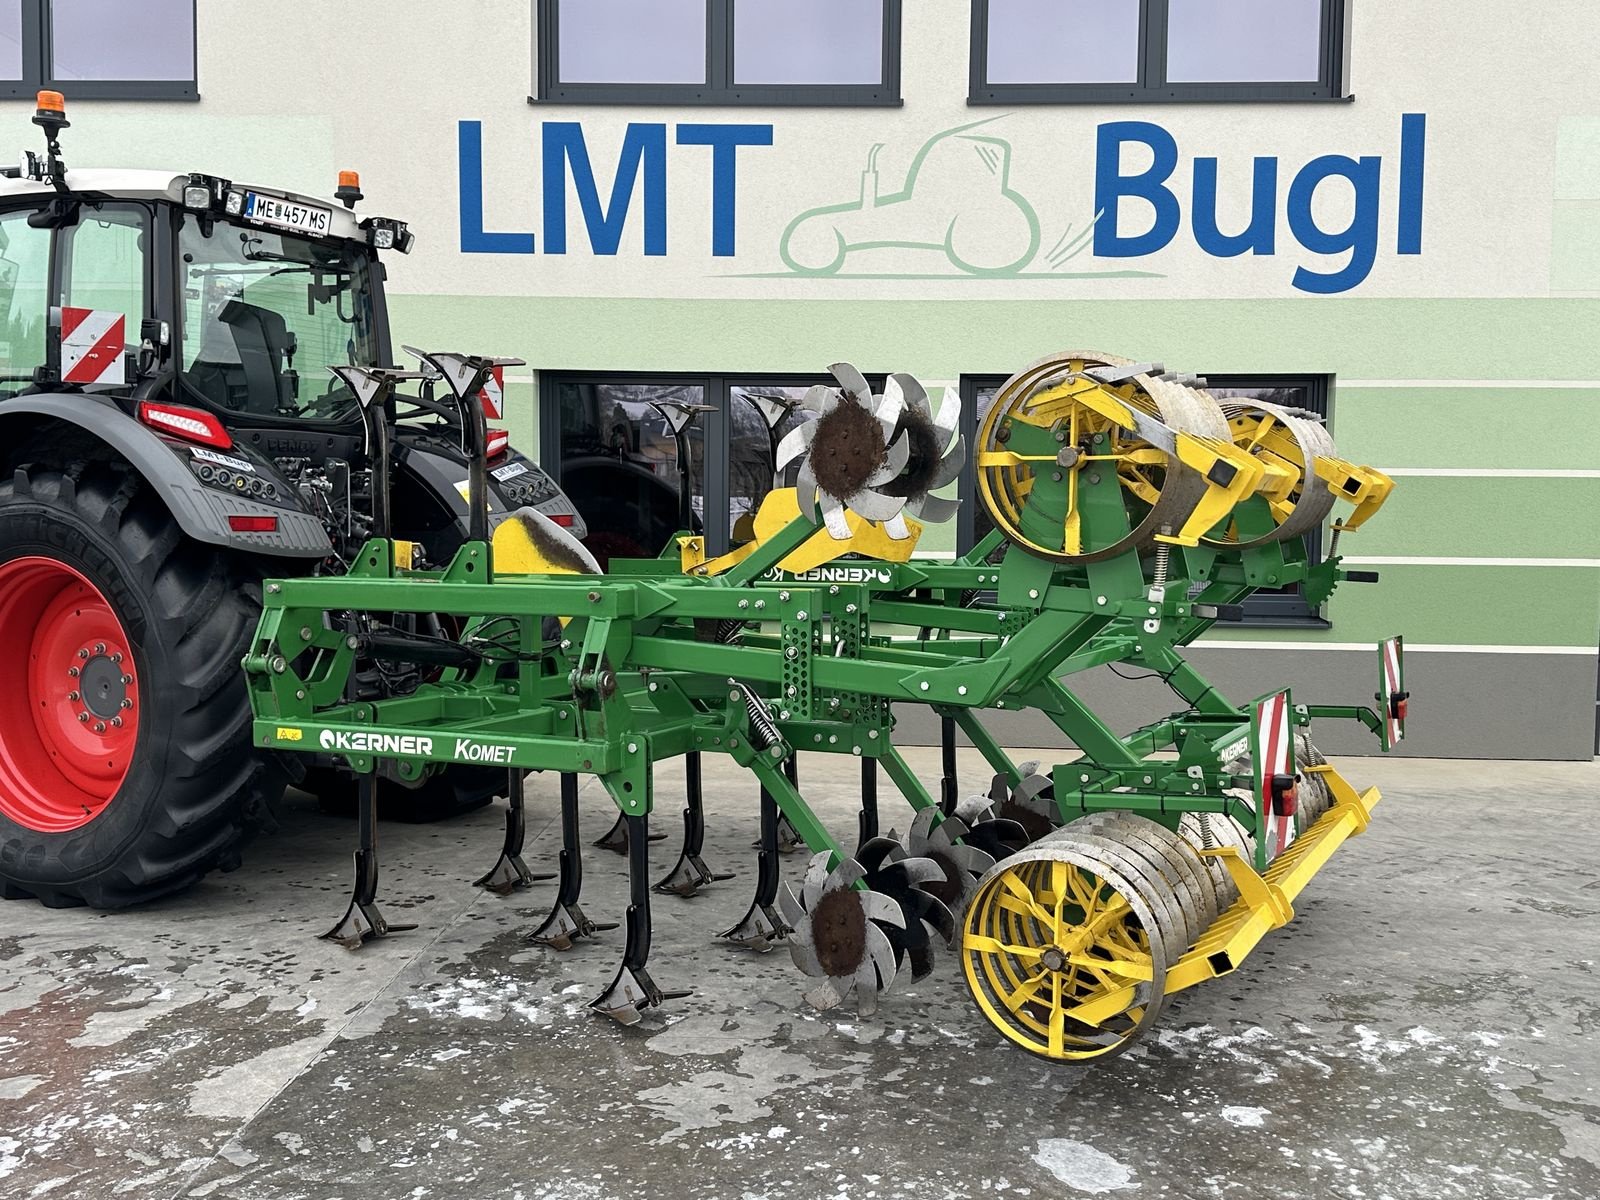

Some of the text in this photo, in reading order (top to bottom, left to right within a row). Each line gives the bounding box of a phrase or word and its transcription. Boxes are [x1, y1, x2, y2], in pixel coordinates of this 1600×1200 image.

[256, 199, 275, 218] ME
[283, 205, 308, 225] 457
[308, 211, 327, 230] MS
[458, 113, 1426, 294] LMT Bugl
[336, 731, 434, 756] KERNER
[1224, 736, 1248, 763] KERNER
